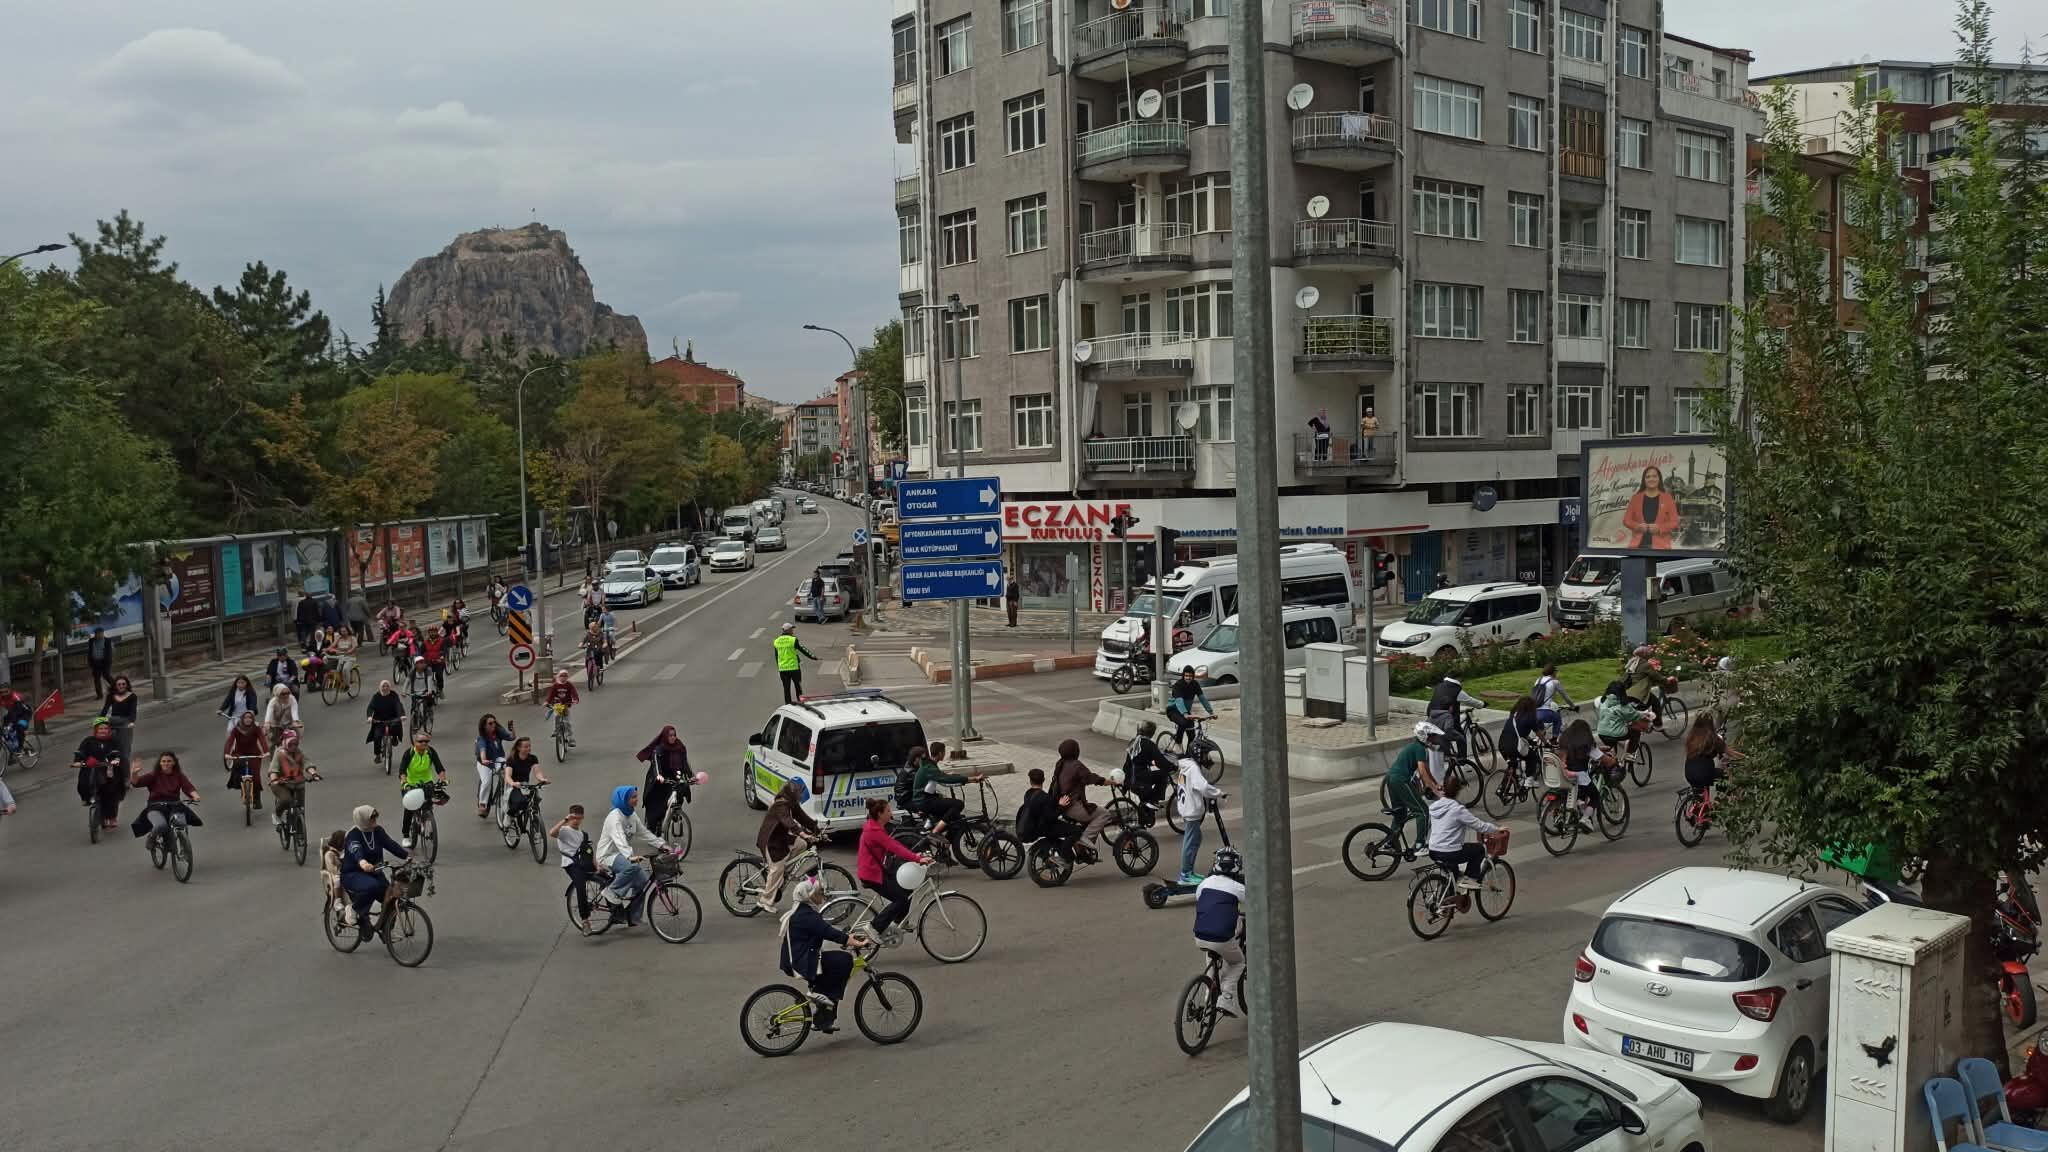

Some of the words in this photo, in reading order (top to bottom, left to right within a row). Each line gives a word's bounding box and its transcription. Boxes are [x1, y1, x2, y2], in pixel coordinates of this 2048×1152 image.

[906, 488, 937, 497] ANKARA
[906, 501, 937, 510] OTOGAR
[904, 529, 952, 538] AFYONKARAHİSAR
[952, 527, 983, 536] BELEDİYESİ
[1030, 527, 1102, 541] KURTULUŞ
[1306, 526, 1344, 536] ÜRÜNLER
[920, 544, 958, 553] KÜTÜPHANESİ
[906, 571, 923, 579] ASKER
[923, 570, 938, 578] ALMA
[938, 569, 953, 577] DAİRE
[954, 567, 985, 579] BAŞKANLIĞI
[1093, 544, 1104, 608] ECZANE
[921, 586, 931, 594] EVİ
[1629, 1039, 1641, 1053] 03
[1646, 1045, 1666, 1059] AHU
[1674, 1051, 1690, 1065] 116
